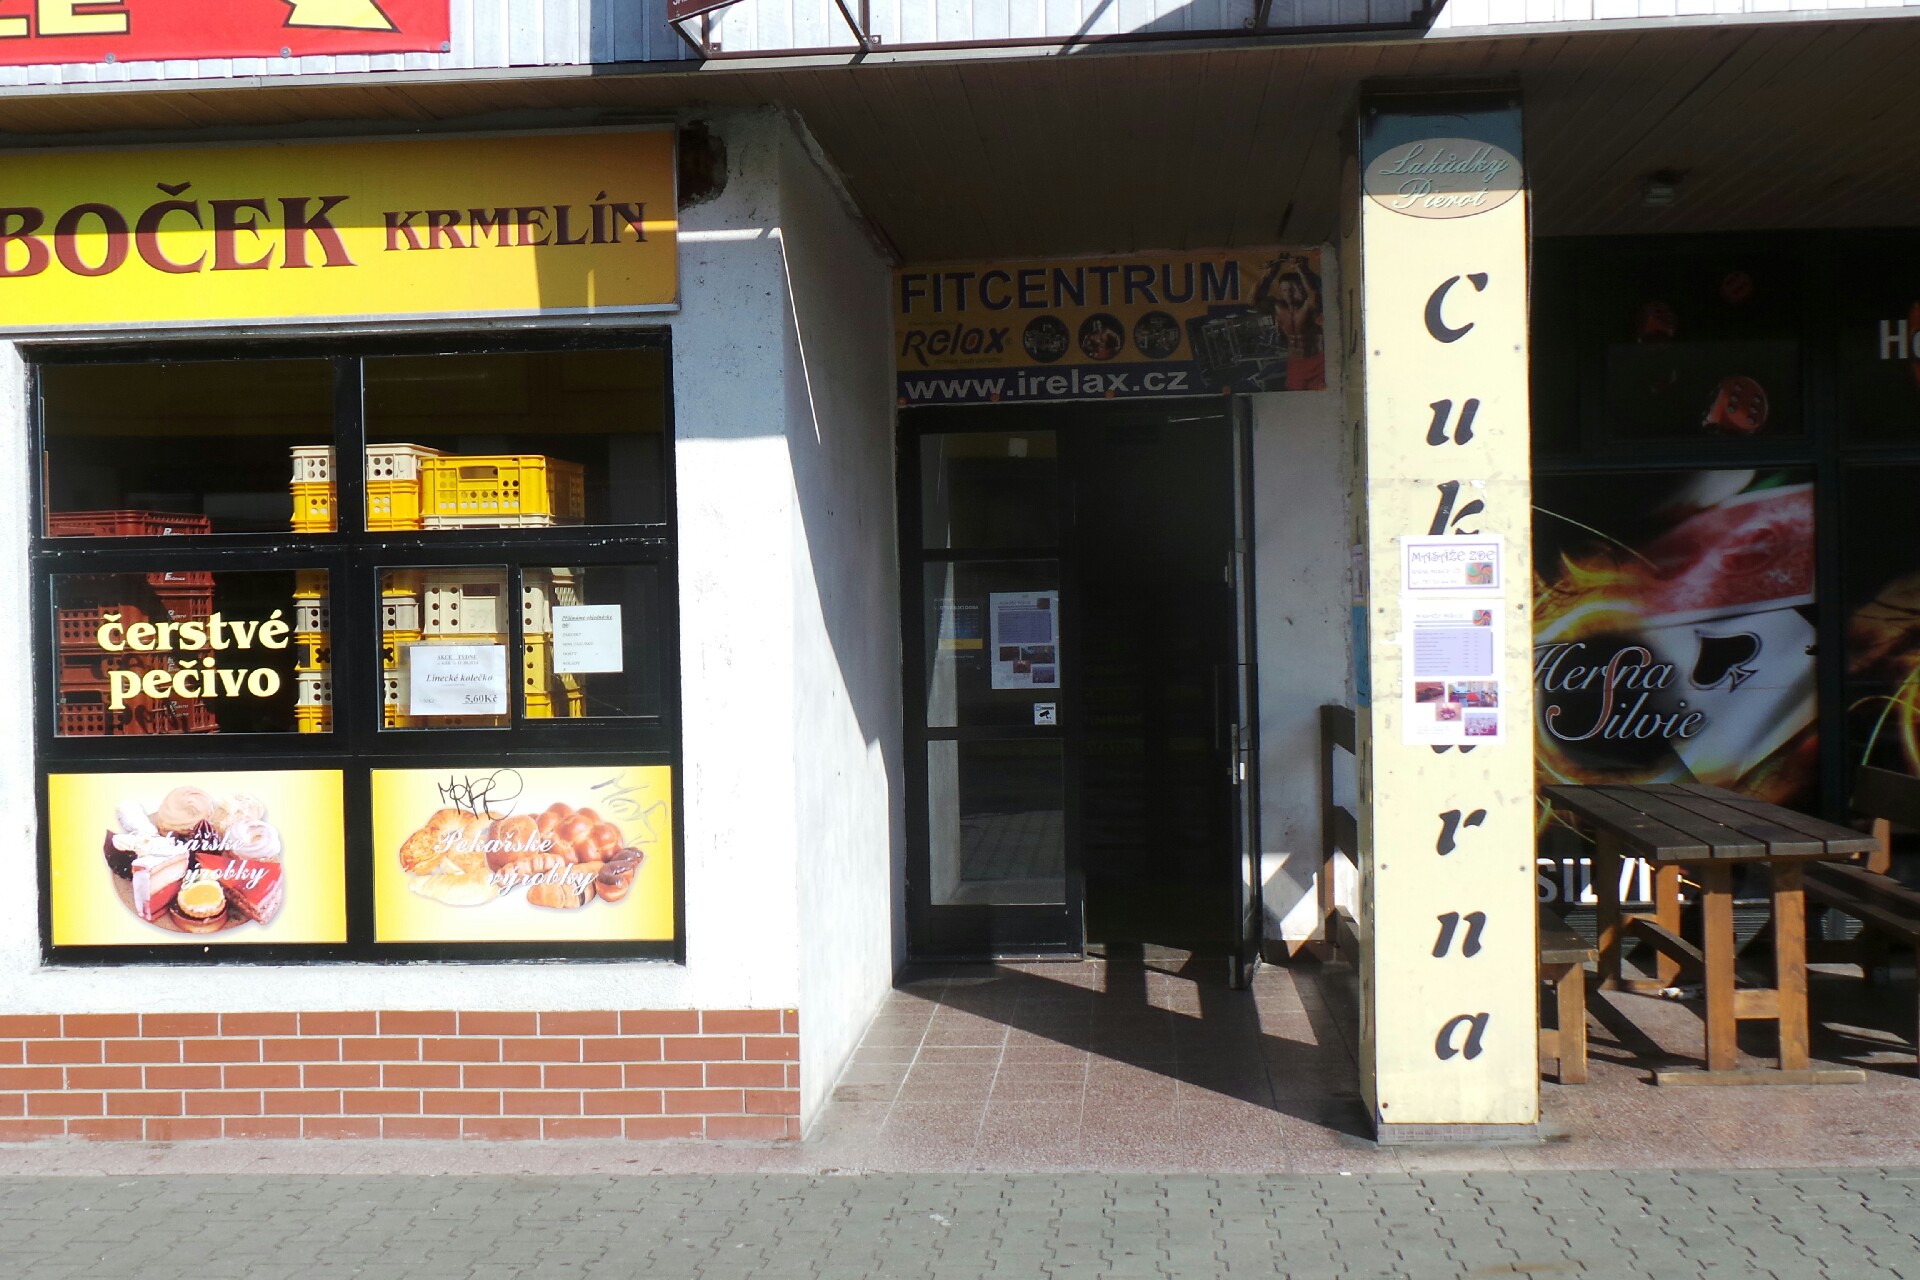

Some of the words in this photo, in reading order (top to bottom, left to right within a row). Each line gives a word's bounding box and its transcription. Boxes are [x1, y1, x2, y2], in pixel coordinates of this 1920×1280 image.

[1379, 144, 1509, 183] Lahůdky
[1392, 177, 1488, 209] Pierot
[383, 190, 648, 252] KRMELÍN
[902, 261, 1240, 314] FITCENTRUM
[904, 368, 1189, 400] www.irelax.cz
[97, 609, 290, 651] čerstvé
[108, 656, 280, 710] pečivo
[426, 673, 459, 682] Linecké
[1424, 272, 1491, 1061] Cukrna
[1531, 643, 1676, 692] Herna
[1546, 646, 1703, 741] Silvie
[432, 829, 558, 854] Pekařské
[487, 863, 600, 896] výrobky
